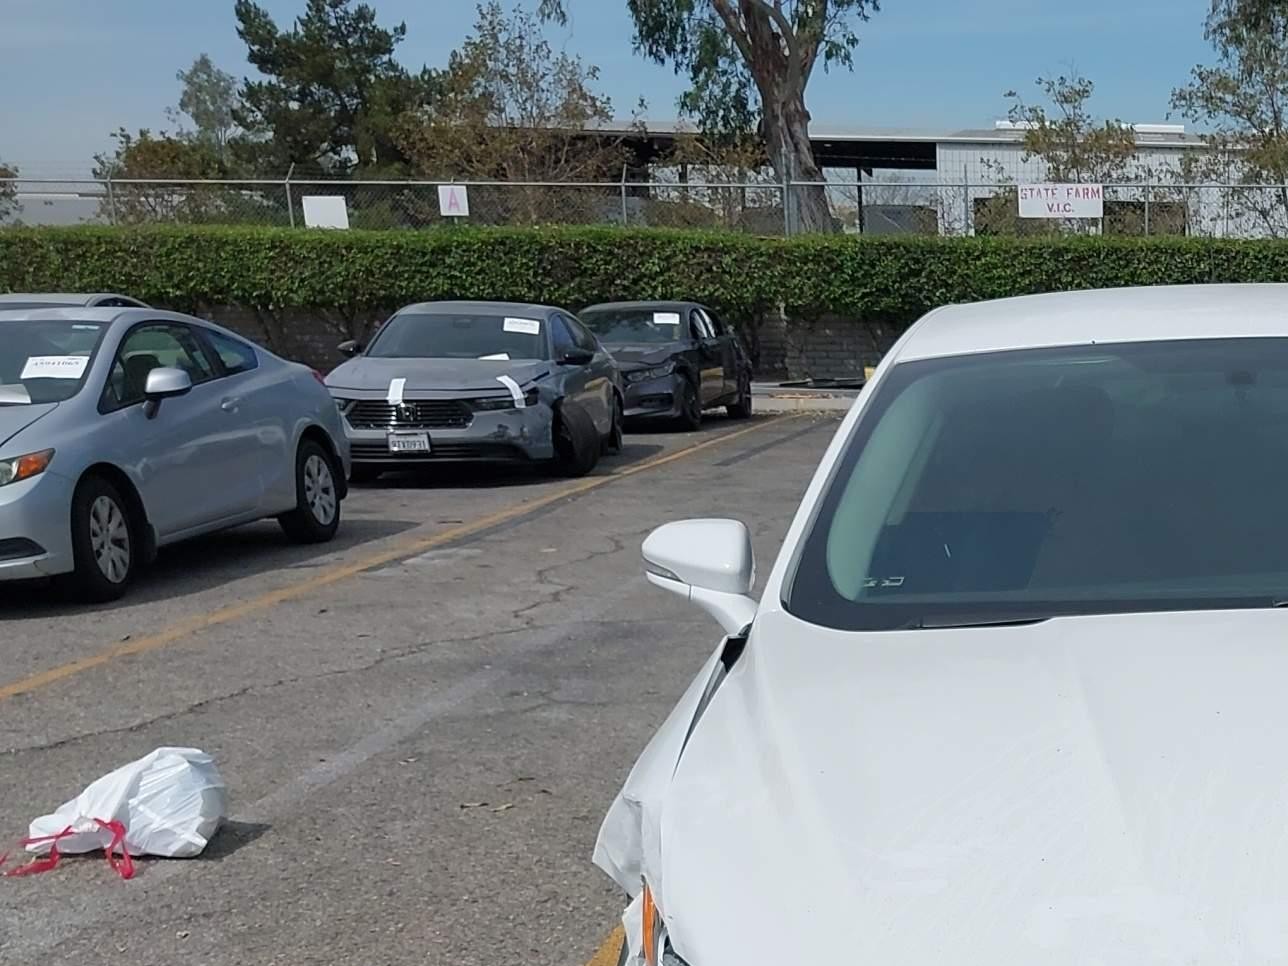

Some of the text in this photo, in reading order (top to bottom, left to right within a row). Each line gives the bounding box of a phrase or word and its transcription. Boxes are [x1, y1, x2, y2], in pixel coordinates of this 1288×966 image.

[446, 187, 460, 212] A
[1020, 187, 1101, 200] STATE FARM
